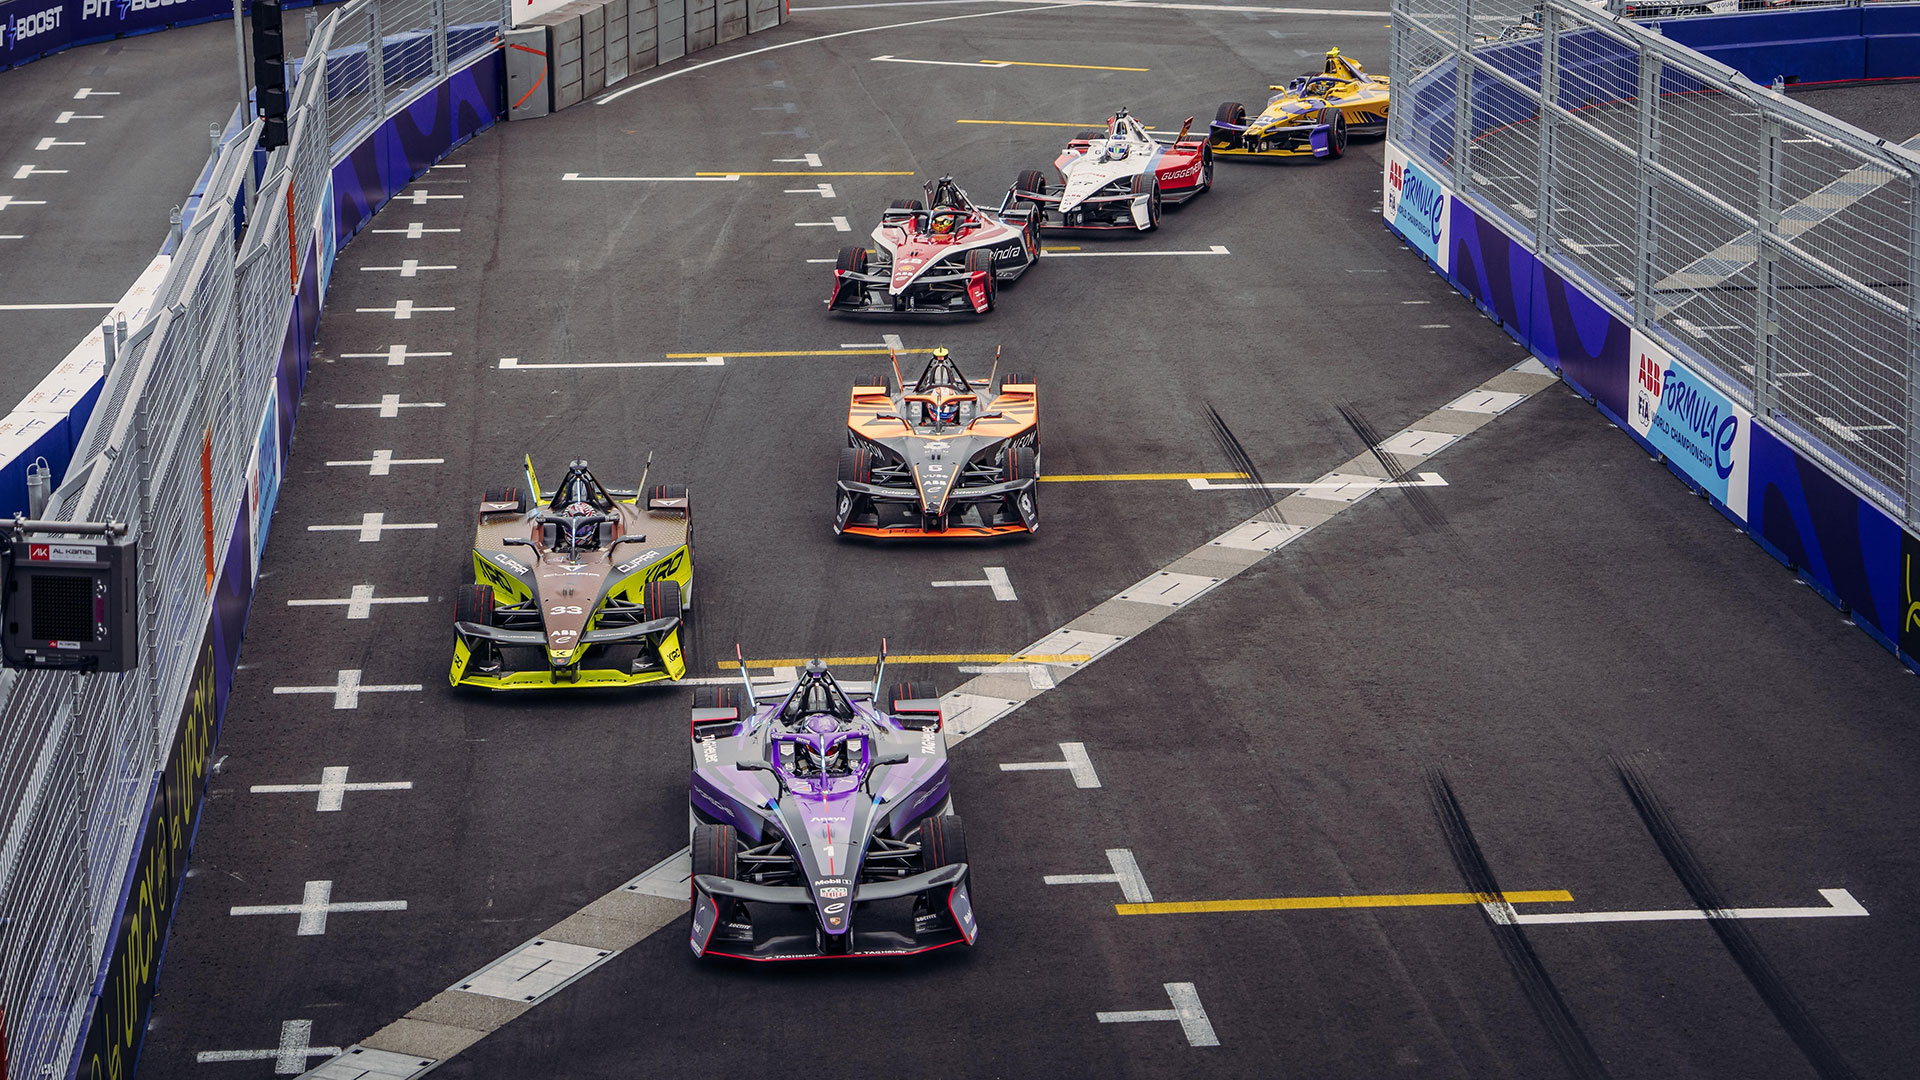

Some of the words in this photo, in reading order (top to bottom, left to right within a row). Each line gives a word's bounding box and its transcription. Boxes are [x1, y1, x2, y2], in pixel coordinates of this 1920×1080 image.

[82, 0, 110, 20] PIT
[17, 5, 62, 41] BOOST
[1389, 160, 1402, 191] ABB
[1402, 168, 1434, 221] FORMULA
[1639, 353, 1660, 398] ABB
[1660, 369, 1718, 447] FORMULA
[1651, 411, 1669, 434] WORLD
[1670, 426, 1713, 469] CHAMPIONSHIP
[494, 553, 529, 577] CUPRA
[617, 550, 660, 574] CUPRA
[550, 605, 583, 615] 33
[550, 629, 578, 637] ABB
[823, 845, 835, 857] 1
[815, 878, 841, 887] Mobil
